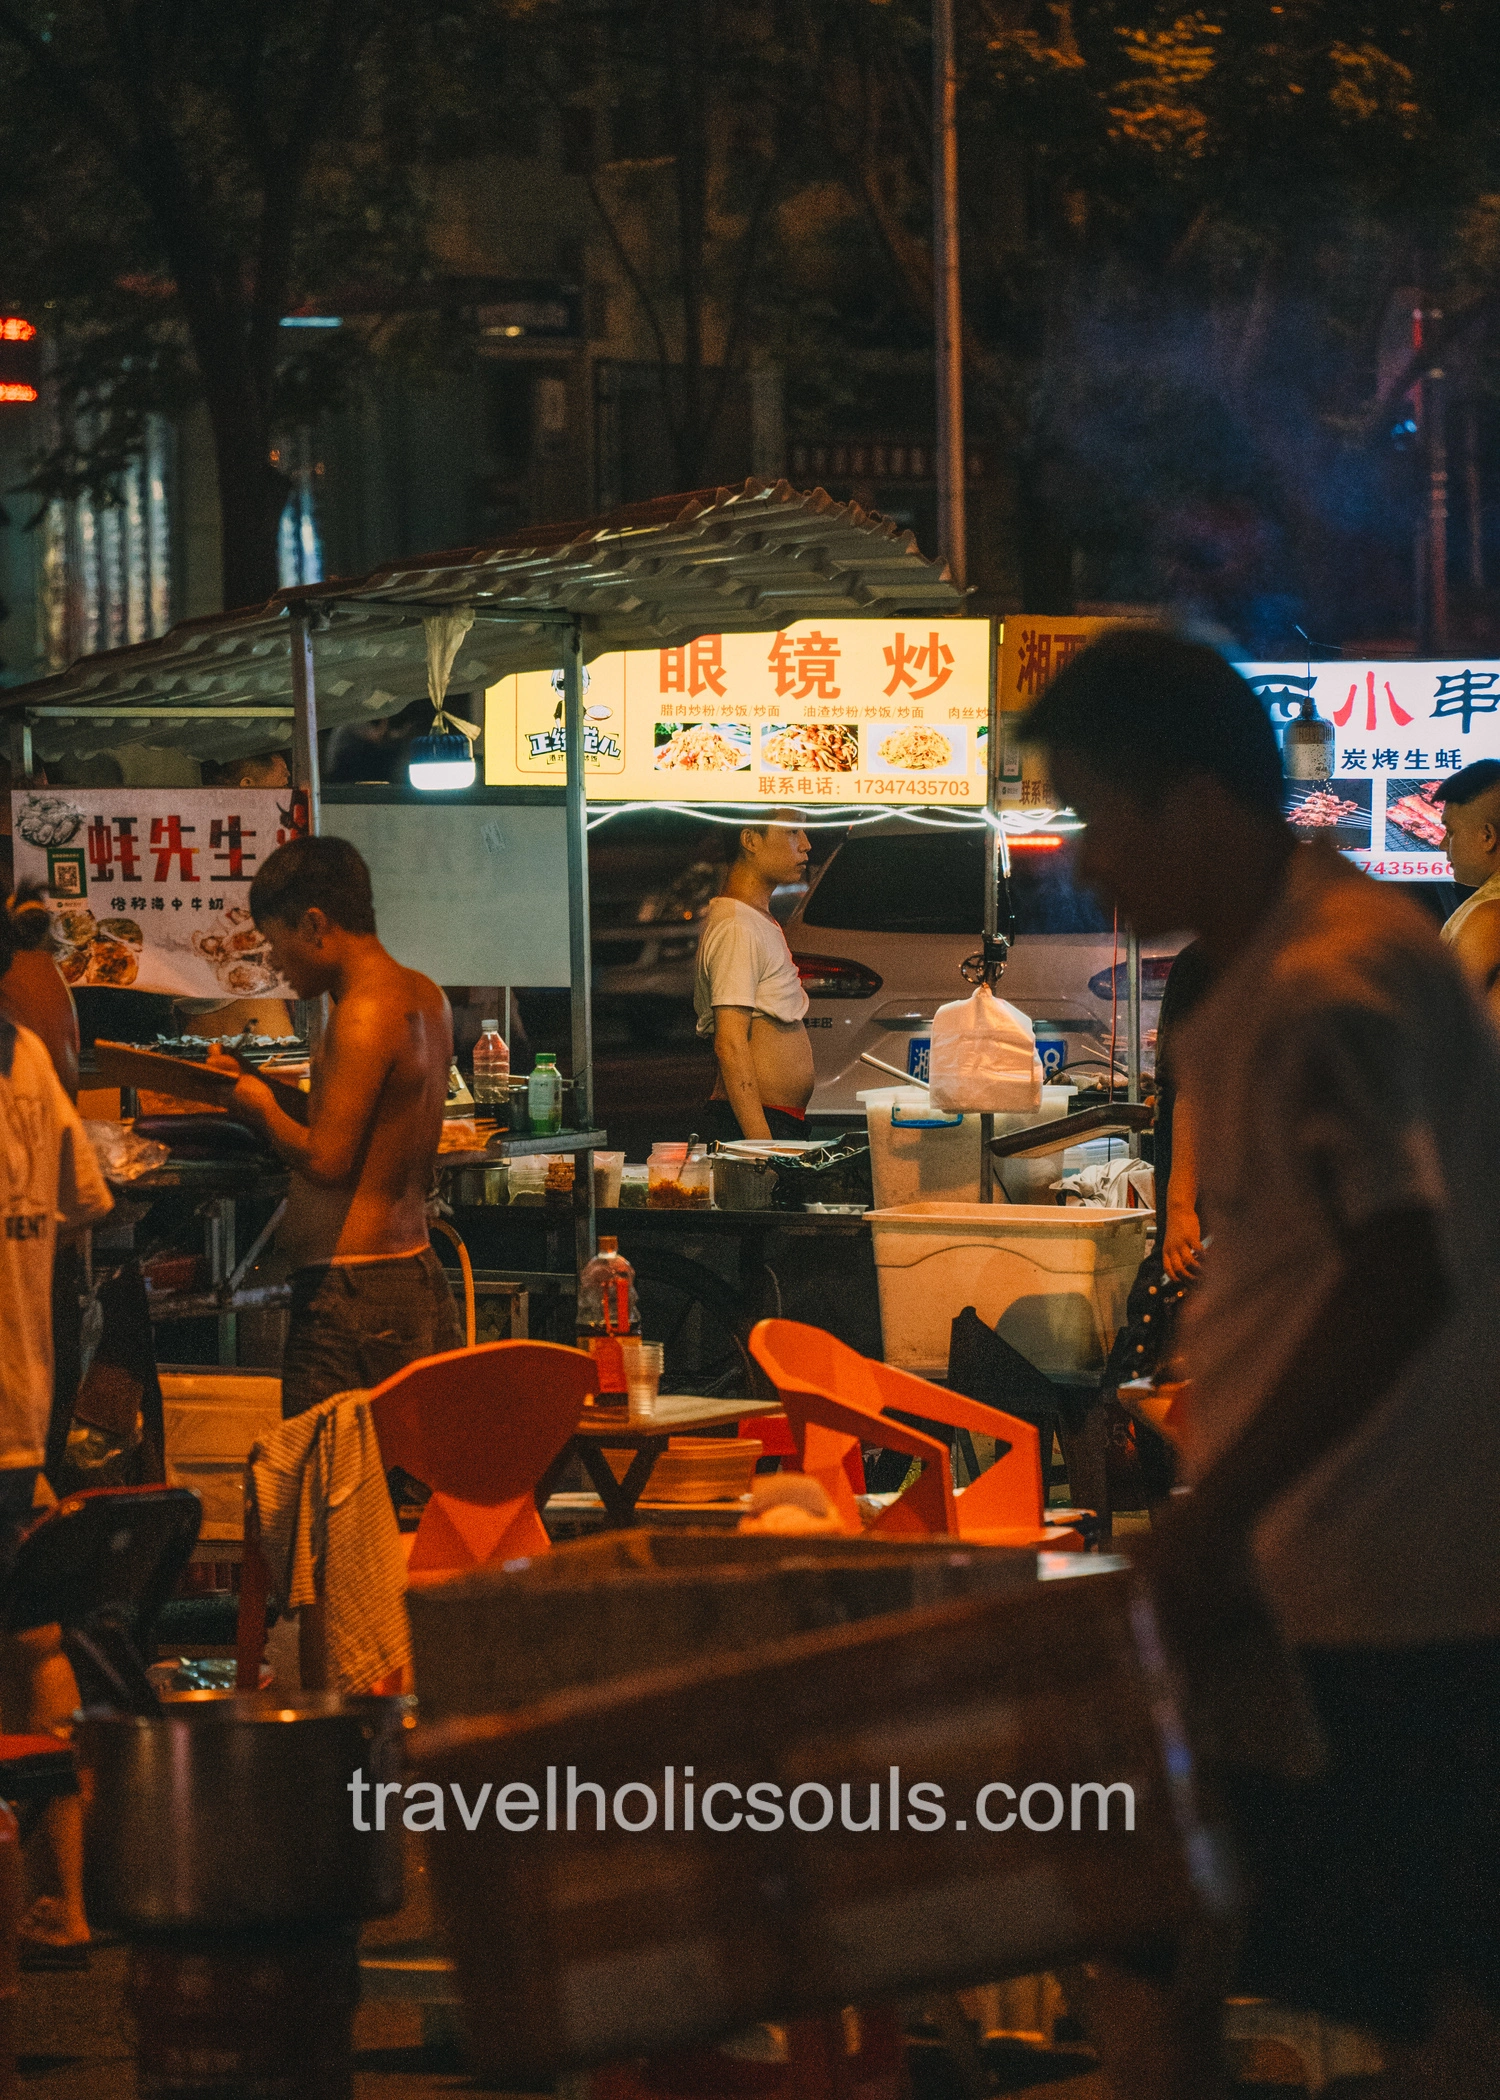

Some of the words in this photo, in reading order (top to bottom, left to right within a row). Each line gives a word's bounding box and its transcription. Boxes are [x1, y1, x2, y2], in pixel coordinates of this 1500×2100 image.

[659, 630, 957, 701] 眼镜炒
[1248, 668, 1500, 734] 西小串
[660, 703, 781, 718] 腊肉炒粉/炒饭/炒面
[803, 705, 925, 720] 油渣炒粉/炒饭/炒面
[1341, 748, 1462, 770] 炭烤生蚝
[854, 779, 970, 797] 17347435703
[1352, 861, 1455, 876] 7435566
[110, 897, 225, 912] 俗称海中牛奶
